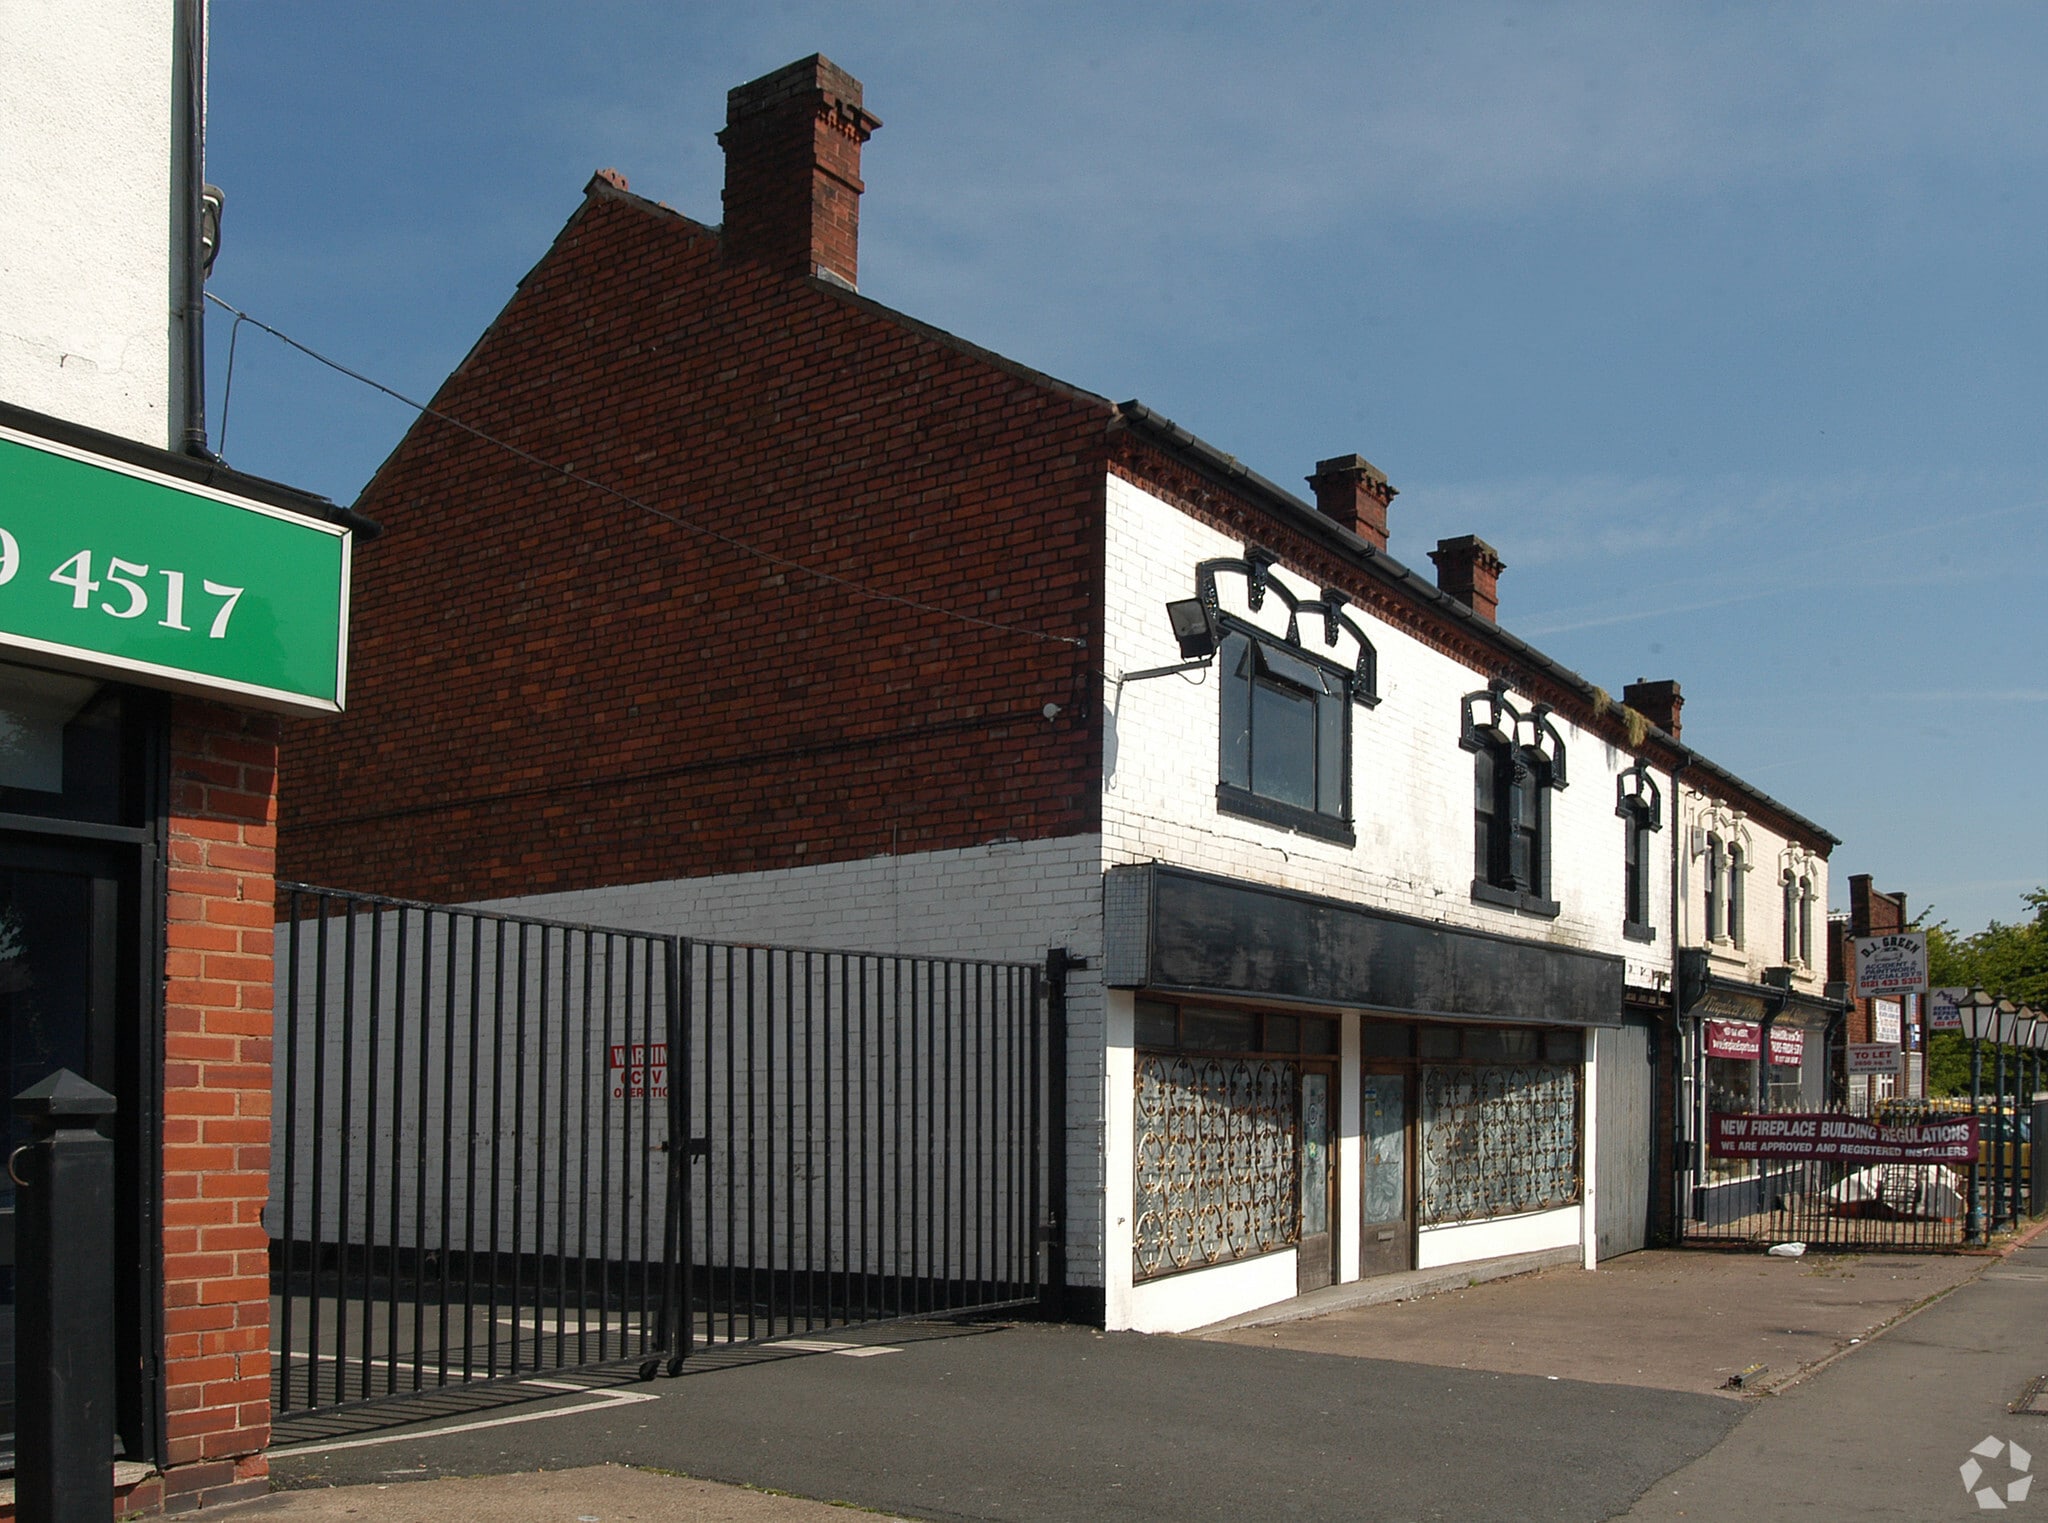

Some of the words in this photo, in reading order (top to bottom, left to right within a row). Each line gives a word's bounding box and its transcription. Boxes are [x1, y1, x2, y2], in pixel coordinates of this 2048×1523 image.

[49, 549, 245, 639] 4517
[1882, 937, 1921, 954] GREEN
[1865, 961, 1908, 969] ACCIDENT
[1865, 966, 1916, 975] PAINTWORK
[1860, 971, 1922, 980] SPECIALISTS
[1860, 980, 1878, 988] 0121
[1854, 1051, 1869, 1059] TO
[1872, 1050, 1892, 1059] LET
[1721, 1119, 1747, 1135] NEW
[1751, 1120, 1816, 1137] FIREPLACE
[1820, 1121, 1877, 1140] BUILDING
[1880, 1124, 1970, 1144] REGULATIONS
[1721, 1141, 1736, 1151] WE
[1738, 1141, 1757, 1152] ARE
[1760, 1142, 1813, 1152] APPROVED
[1815, 1143, 1837, 1153] AND
[1839, 1144, 1902, 1156] REGISTERED
[1904, 1146, 1969, 1158] INSTALLERS
